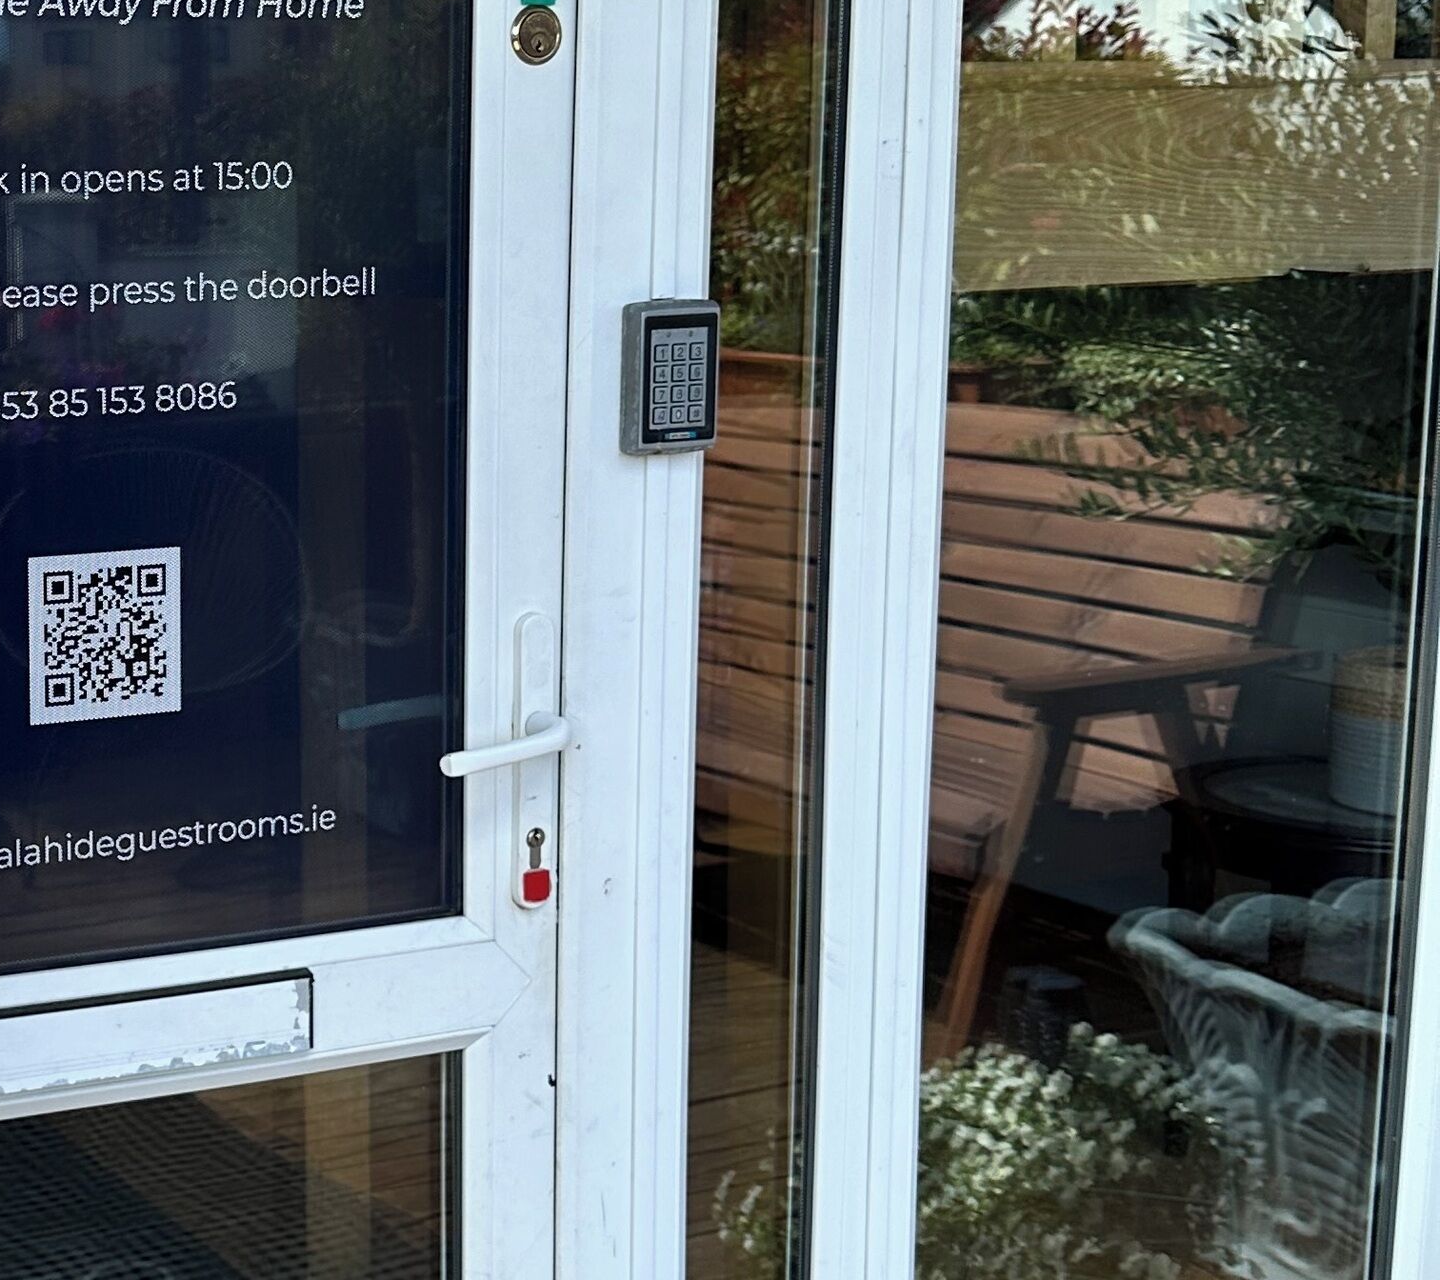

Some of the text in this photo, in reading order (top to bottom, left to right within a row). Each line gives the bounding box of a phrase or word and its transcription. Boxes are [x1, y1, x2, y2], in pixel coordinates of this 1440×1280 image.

[21, 163, 50, 194] in
[61, 169, 164, 200] opens
[173, 165, 204, 192] at
[213, 160, 293, 190] 15:00
[90, 281, 176, 313] press
[183, 272, 238, 302] the
[247, 266, 376, 300] doorbell
[49, 388, 89, 418] 85
[96, 385, 146, 415] 153
[155, 380, 237, 412] 8086
